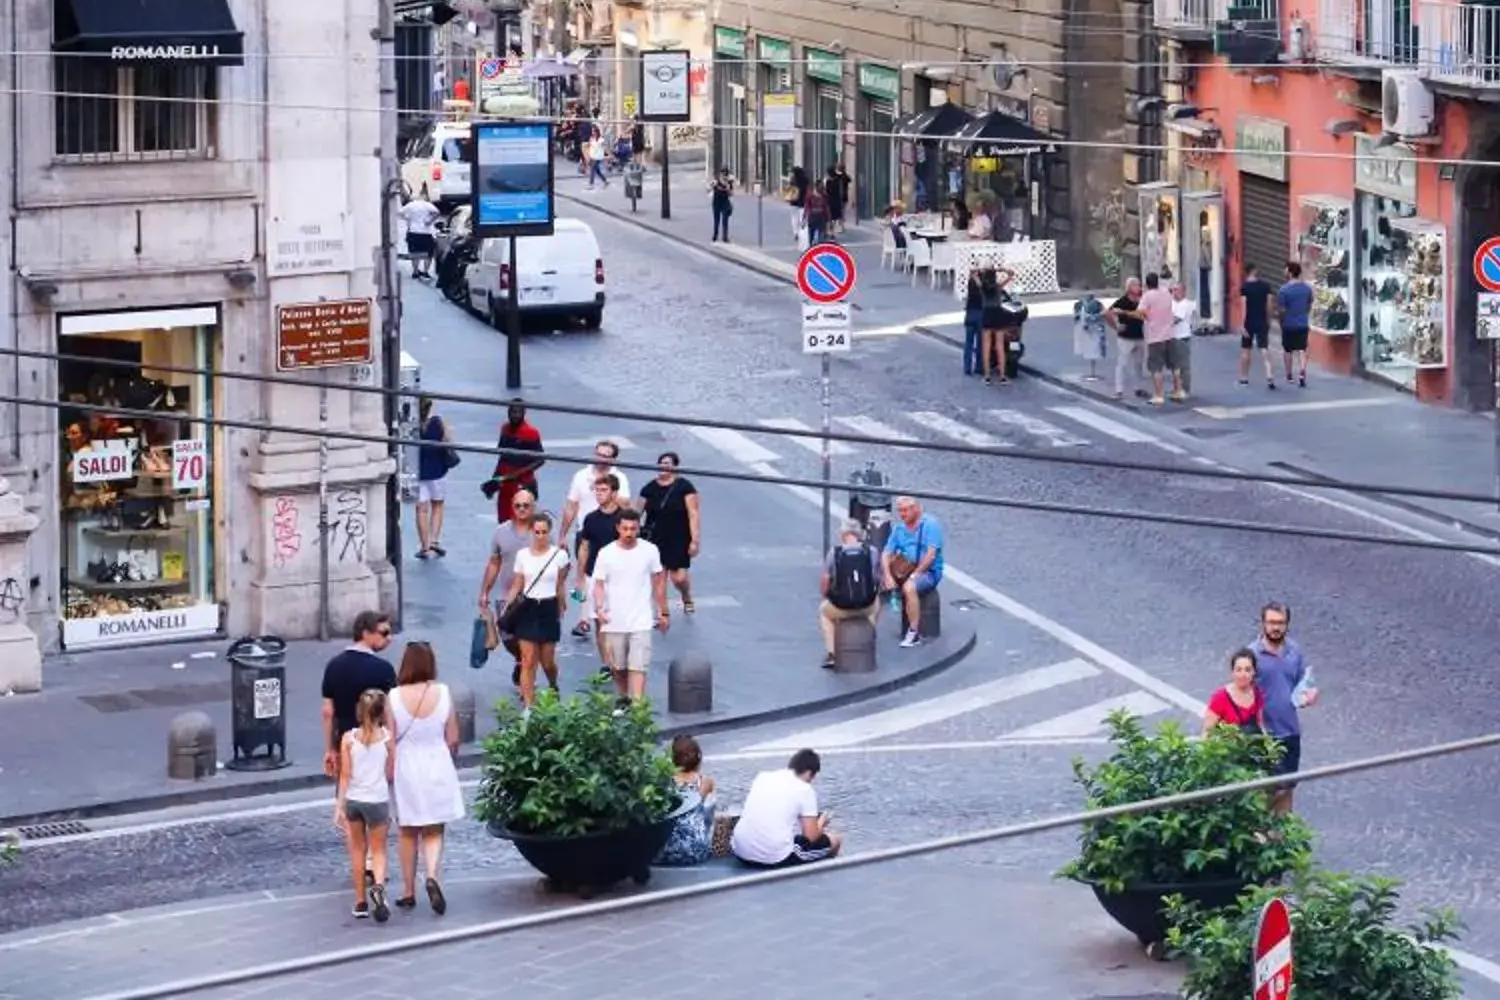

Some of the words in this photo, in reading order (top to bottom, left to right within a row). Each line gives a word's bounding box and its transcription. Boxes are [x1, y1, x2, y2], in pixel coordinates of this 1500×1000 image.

[111, 45, 219, 60] ROMANELLI
[78, 455, 127, 477] SALDI
[175, 456, 204, 482] 70
[99, 613, 187, 637] ROMANELLI
